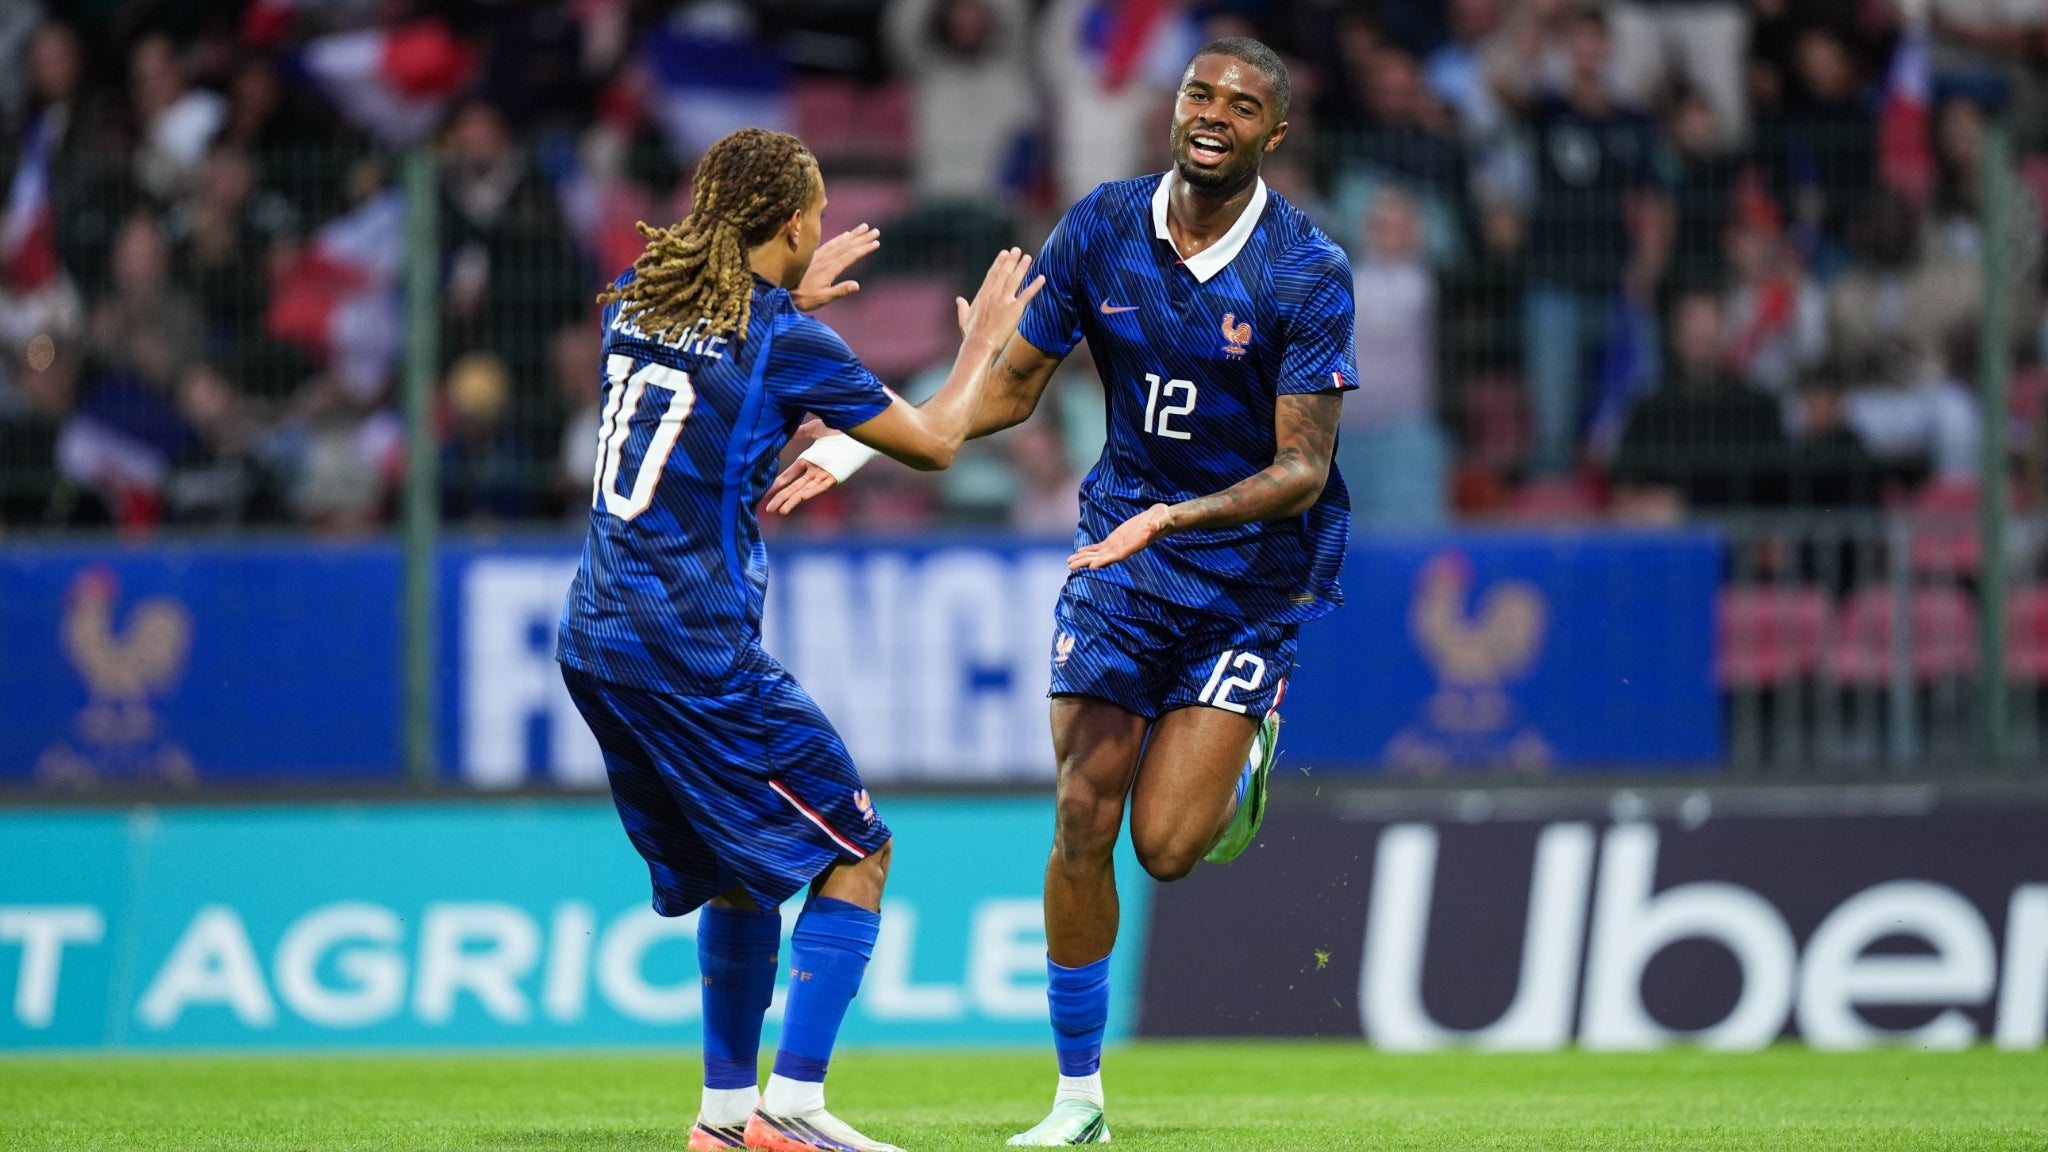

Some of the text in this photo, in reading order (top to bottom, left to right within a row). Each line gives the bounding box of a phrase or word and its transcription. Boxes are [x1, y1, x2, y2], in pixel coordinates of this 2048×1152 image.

[593, 353, 697, 521] 10
[1144, 372, 1198, 440] 12
[461, 556, 1069, 788] FNC
[1198, 650, 1266, 714] 12
[137, 898, 1053, 1028] AGRICLE
[1358, 822, 2048, 1053] Uber
